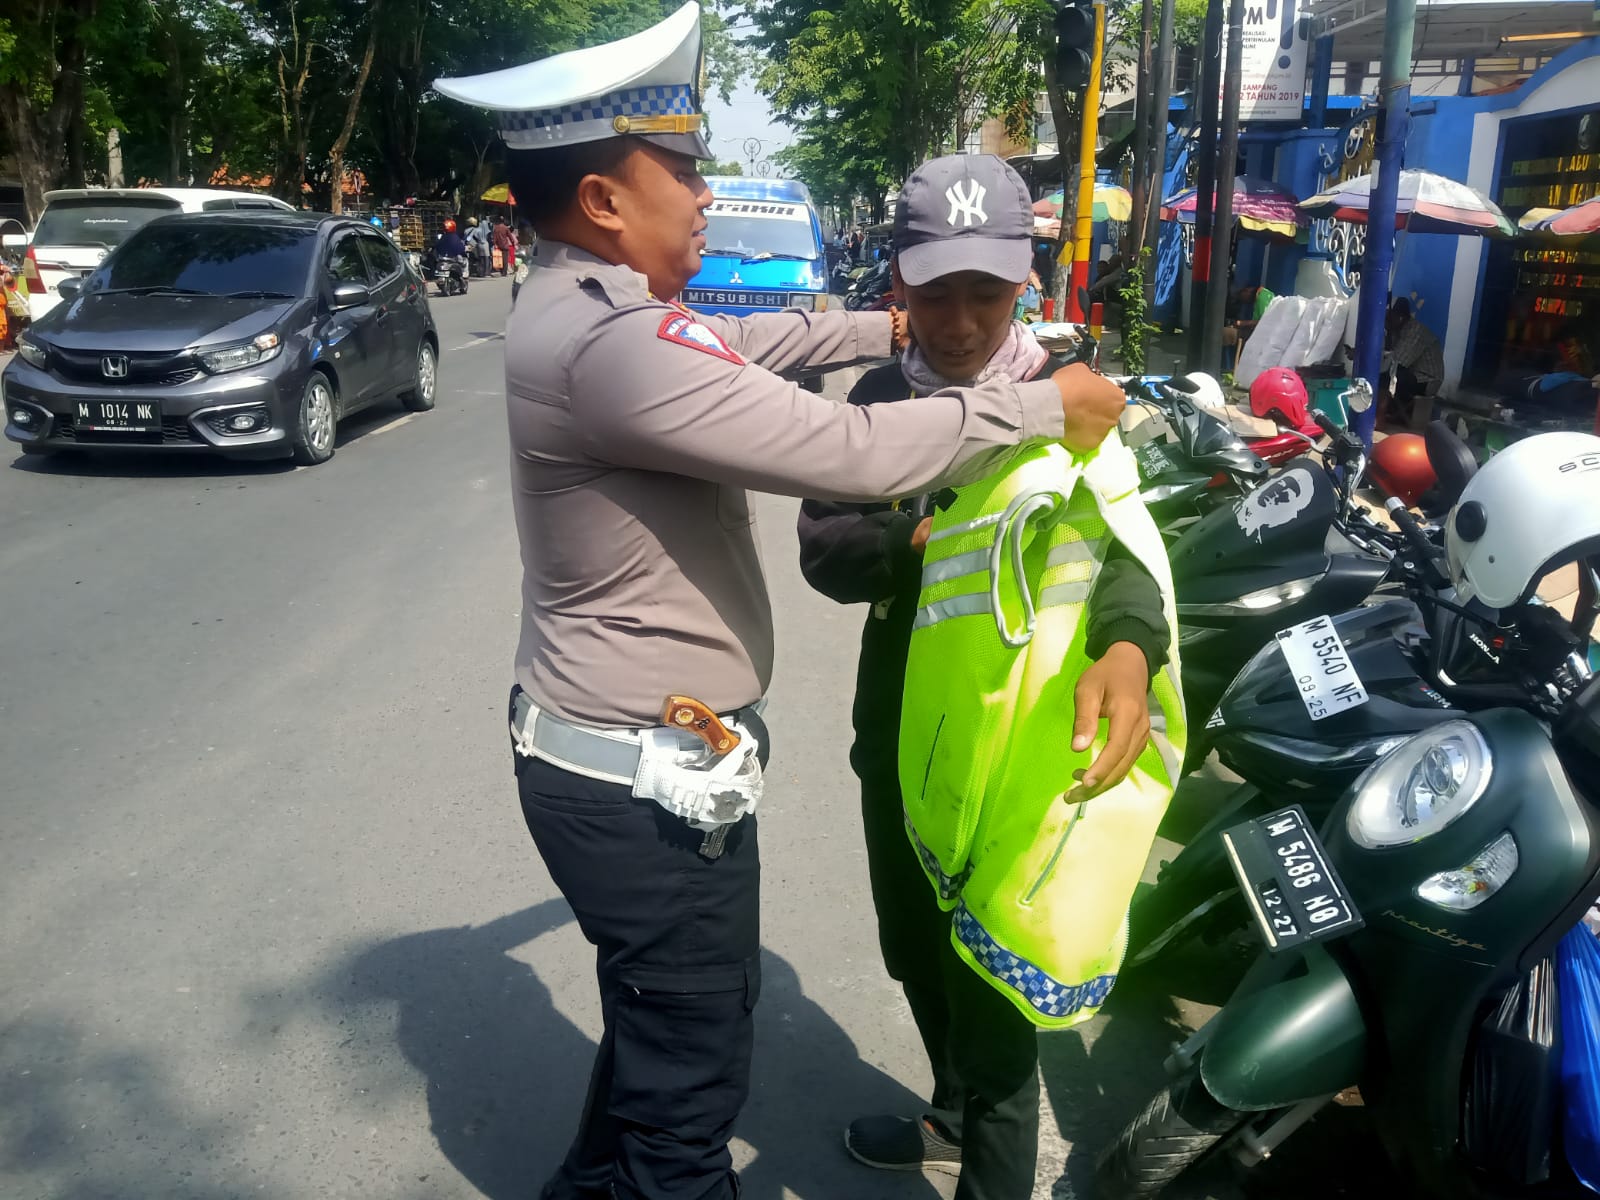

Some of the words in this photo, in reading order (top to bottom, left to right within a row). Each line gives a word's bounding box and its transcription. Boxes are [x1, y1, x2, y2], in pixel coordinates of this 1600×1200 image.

[1246, 92, 1276, 100] TAHUN
[1278, 92, 1300, 101] 2019
[688, 292, 781, 305] MITSUBISHI
[78, 402, 89, 418] M
[100, 403, 129, 419] 1014
[136, 404, 153, 420] NK
[1302, 618, 1328, 634] M
[1312, 636, 1348, 675] 5540
[1331, 682, 1362, 703] NF
[1266, 817, 1297, 837] M
[1277, 840, 1322, 888] 5486
